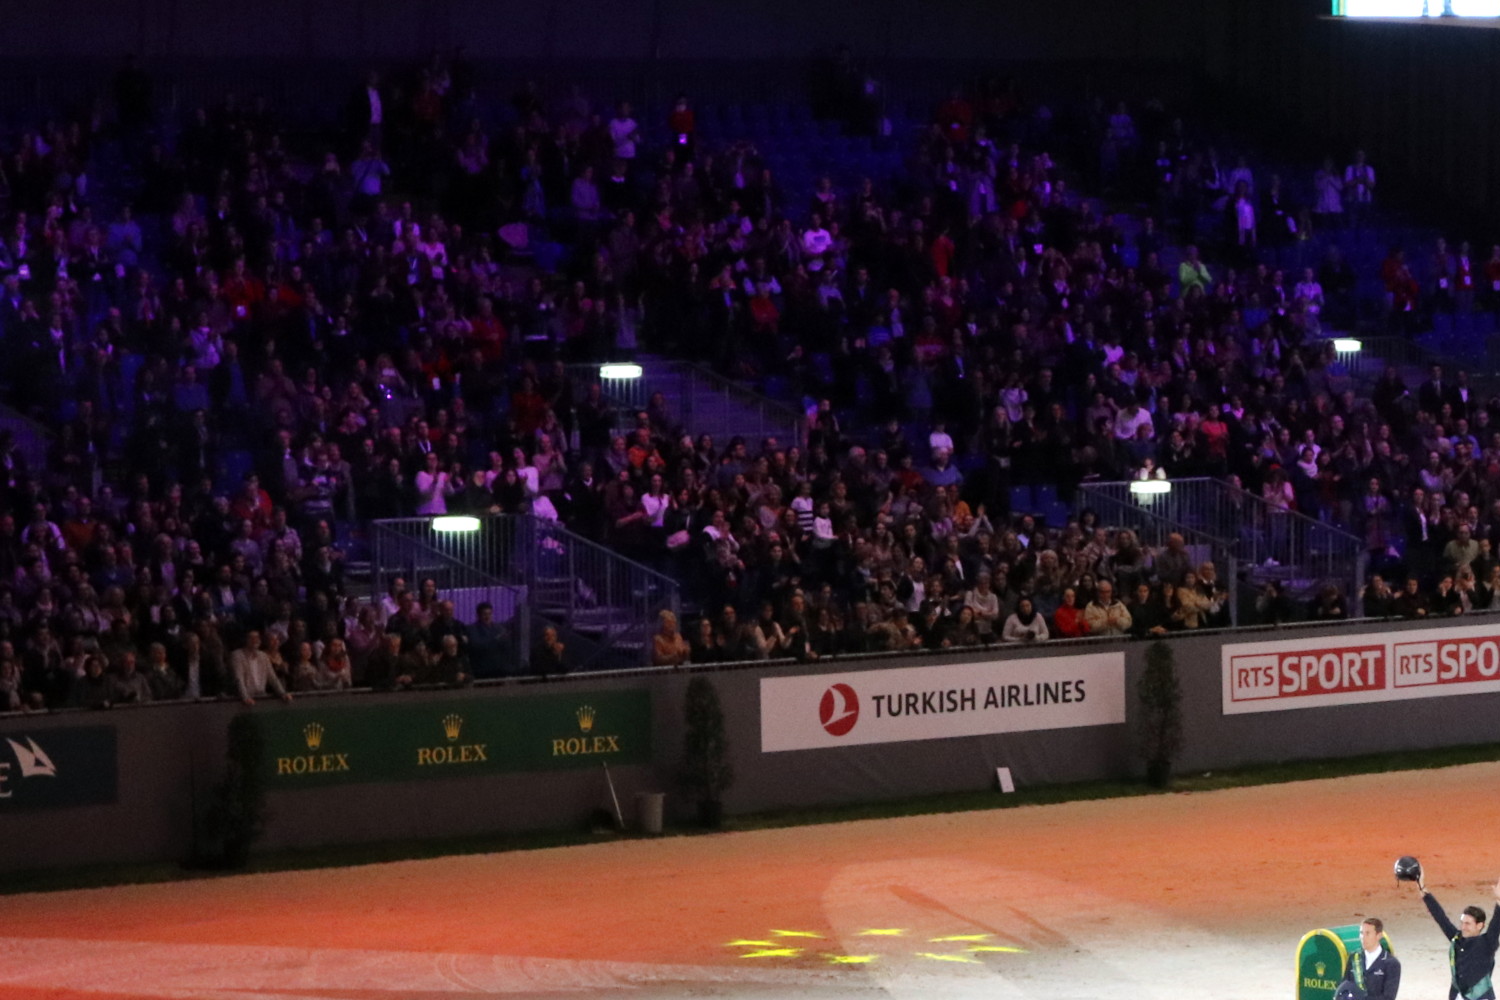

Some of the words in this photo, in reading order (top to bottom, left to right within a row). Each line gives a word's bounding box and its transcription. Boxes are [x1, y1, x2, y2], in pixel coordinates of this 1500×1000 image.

[1237, 665, 1275, 689] RTS
[1281, 650, 1382, 693] SPORT
[1400, 652, 1434, 675] RTS
[872, 687, 976, 718] TURKISH
[984, 679, 1087, 710] AIRLINES
[416, 743, 488, 766] ROLEX
[552, 735, 620, 757] ROLEX
[277, 753, 350, 776] ROLEX
[1304, 977, 1337, 990] ROLEX
